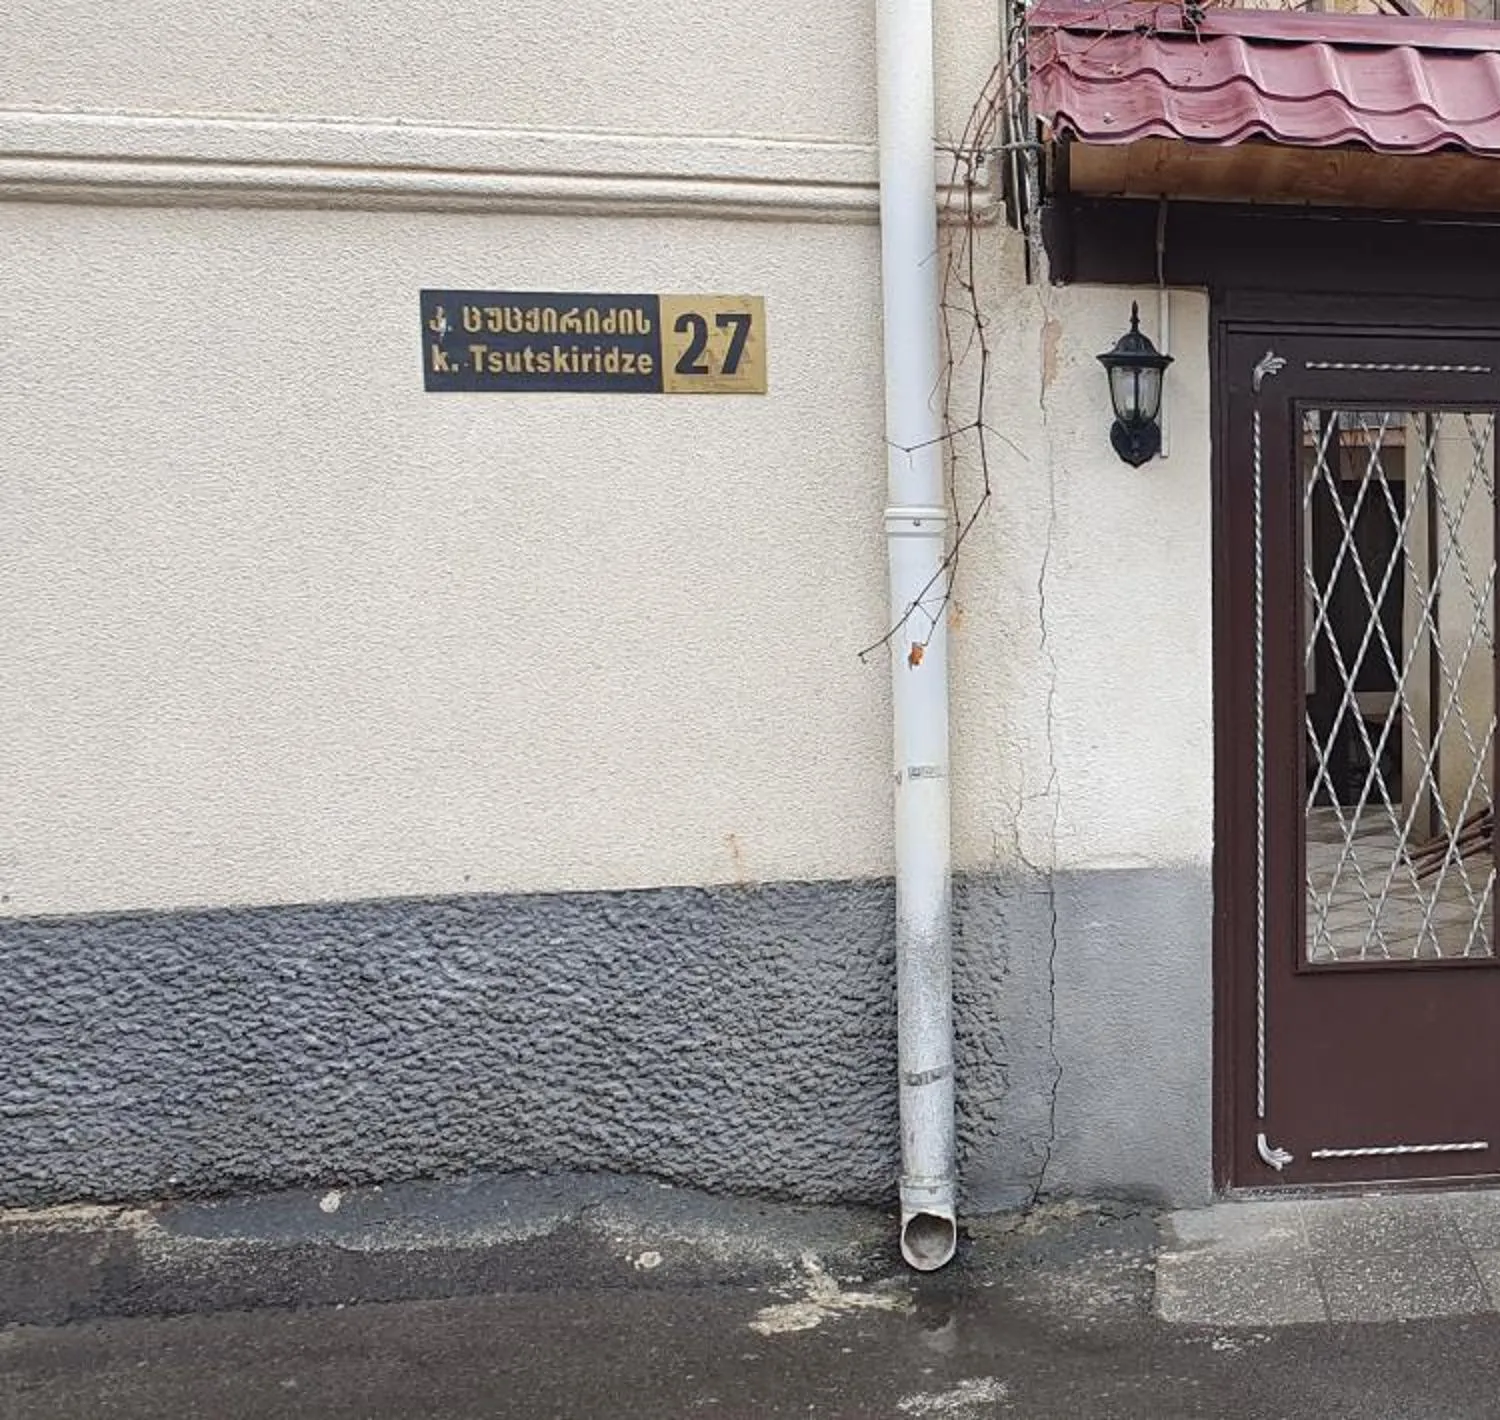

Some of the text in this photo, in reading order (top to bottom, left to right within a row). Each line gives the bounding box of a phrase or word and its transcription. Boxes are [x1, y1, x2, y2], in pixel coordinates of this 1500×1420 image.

[462, 304, 652, 335] ცუცქირიძის
[431, 344, 653, 374] k. Tsutskiridze
[673, 313, 754, 376] 27
